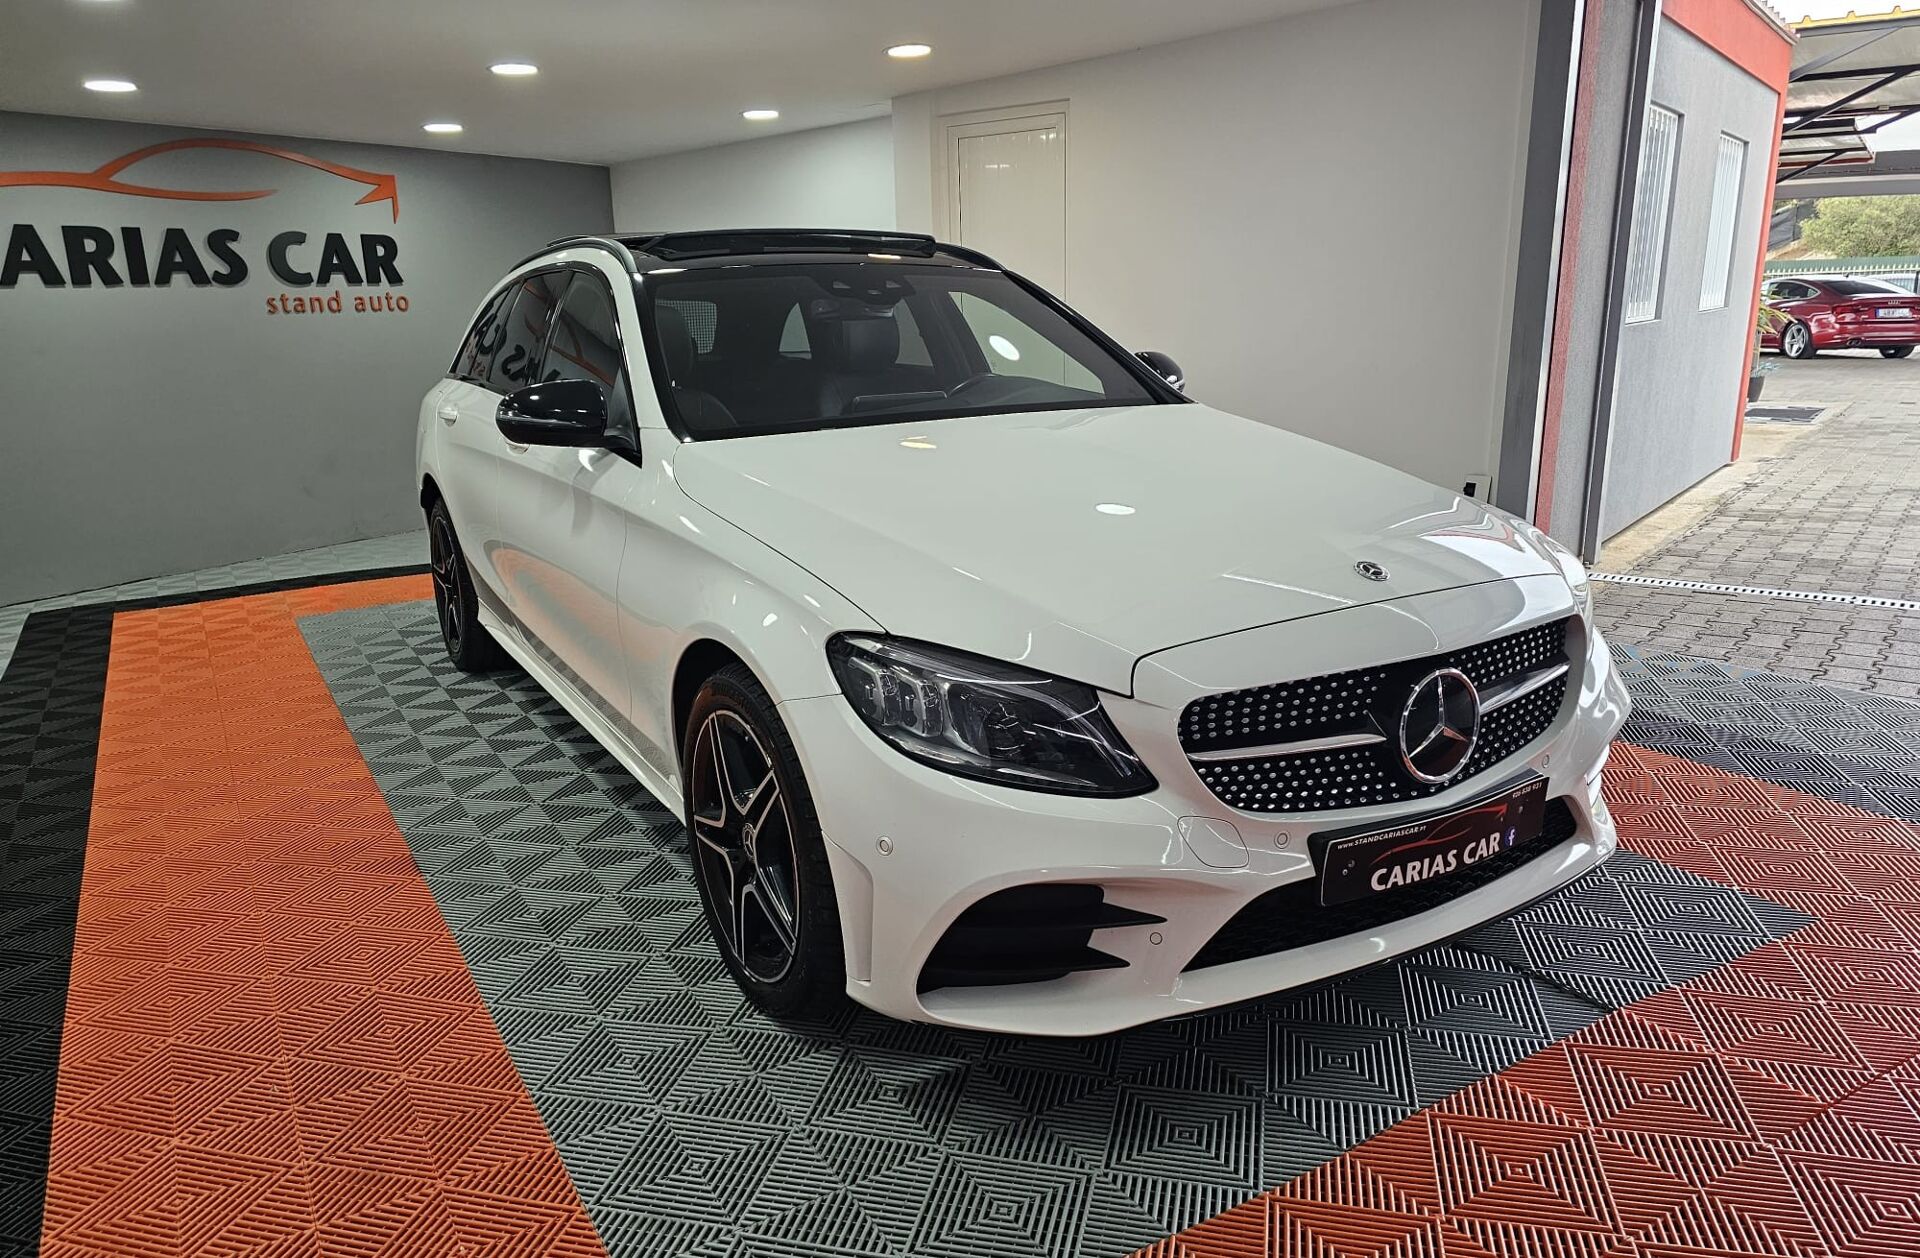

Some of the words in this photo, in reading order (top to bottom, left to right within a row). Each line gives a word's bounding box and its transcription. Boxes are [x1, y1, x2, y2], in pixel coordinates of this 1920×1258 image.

[266, 230, 404, 287] CAR
[266, 289, 342, 314] stand
[354, 291, 409, 313] auto
[1370, 849, 1458, 891] CARIAS
[1463, 832, 1500, 864] CAR
